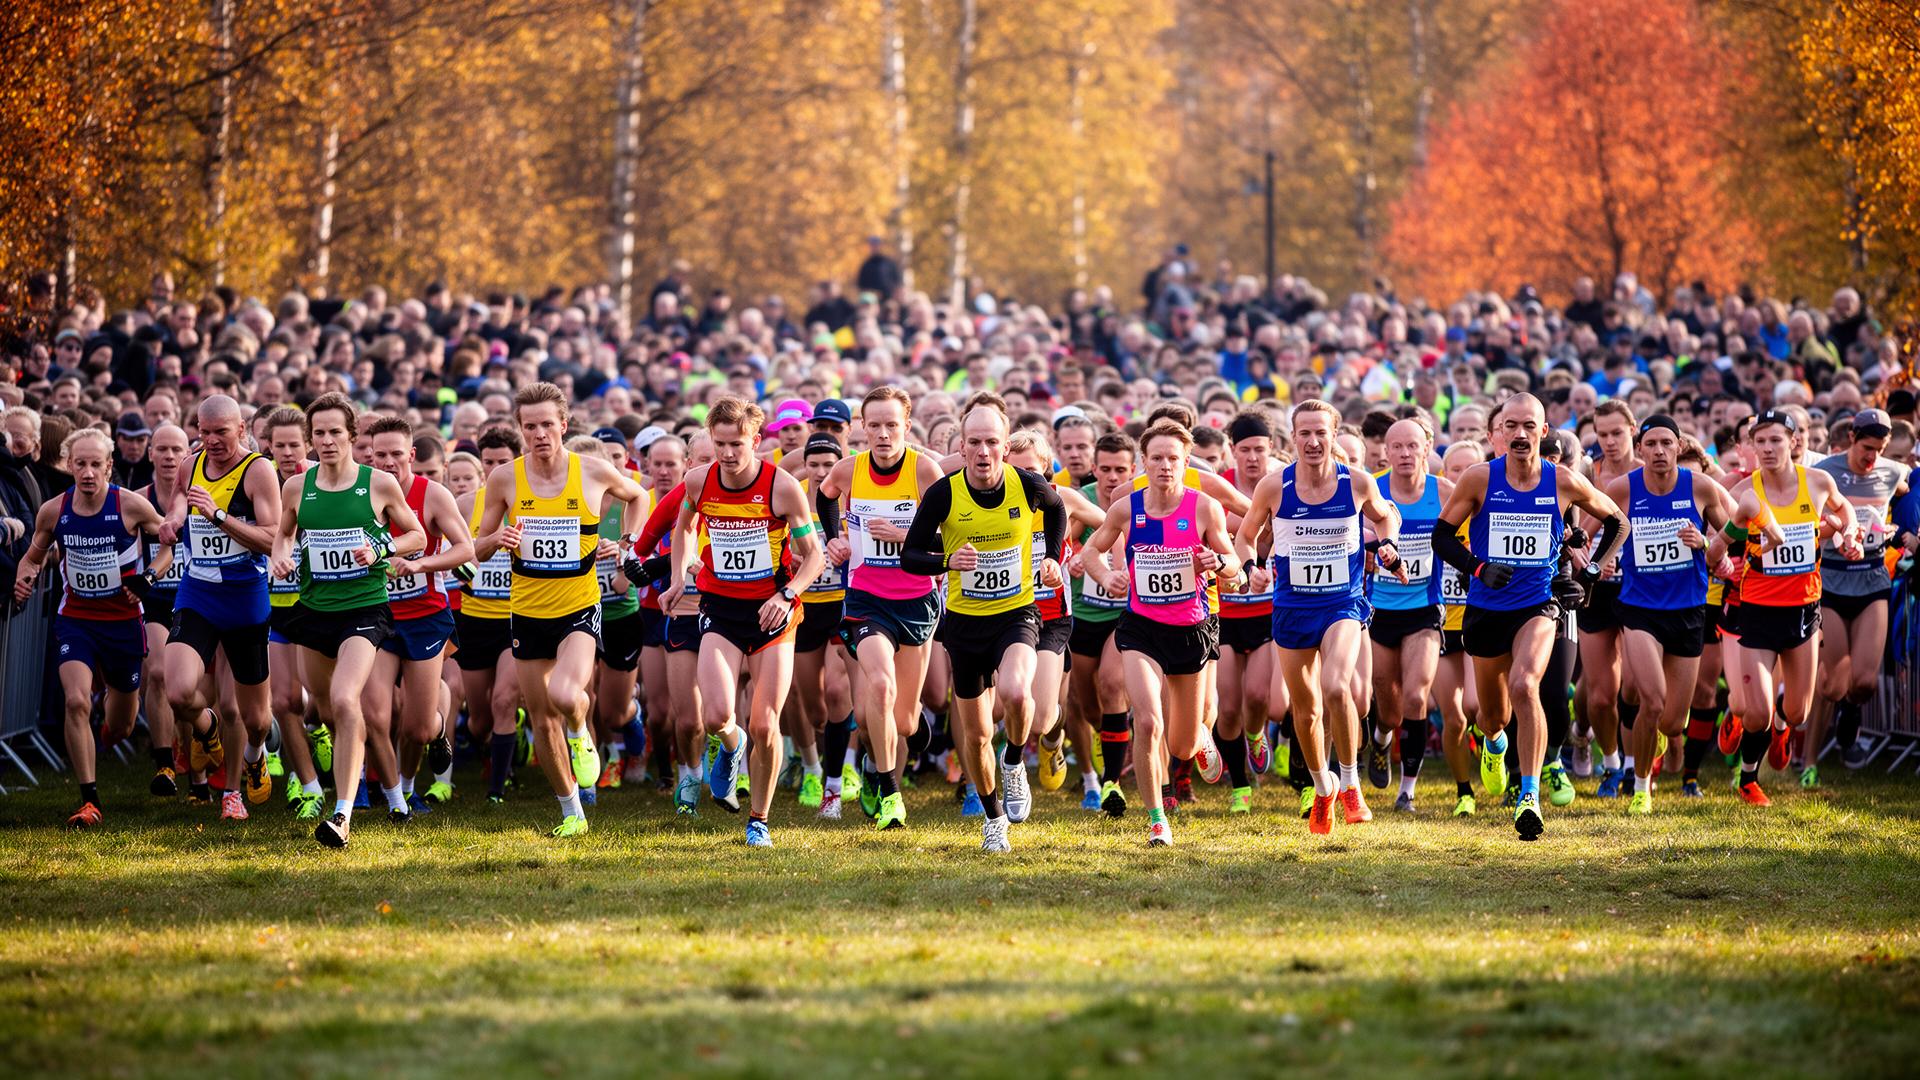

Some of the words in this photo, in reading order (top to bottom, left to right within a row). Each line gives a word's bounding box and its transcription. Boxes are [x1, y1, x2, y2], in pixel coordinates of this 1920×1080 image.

[532, 539, 568, 559] 633
[1502, 535, 1536, 556] 108
[1645, 541, 1680, 563] 575
[320, 550, 354, 570] 104
[722, 550, 756, 570] 267
[1148, 572, 1183, 594] 683
[1303, 564, 1333, 584] 171
